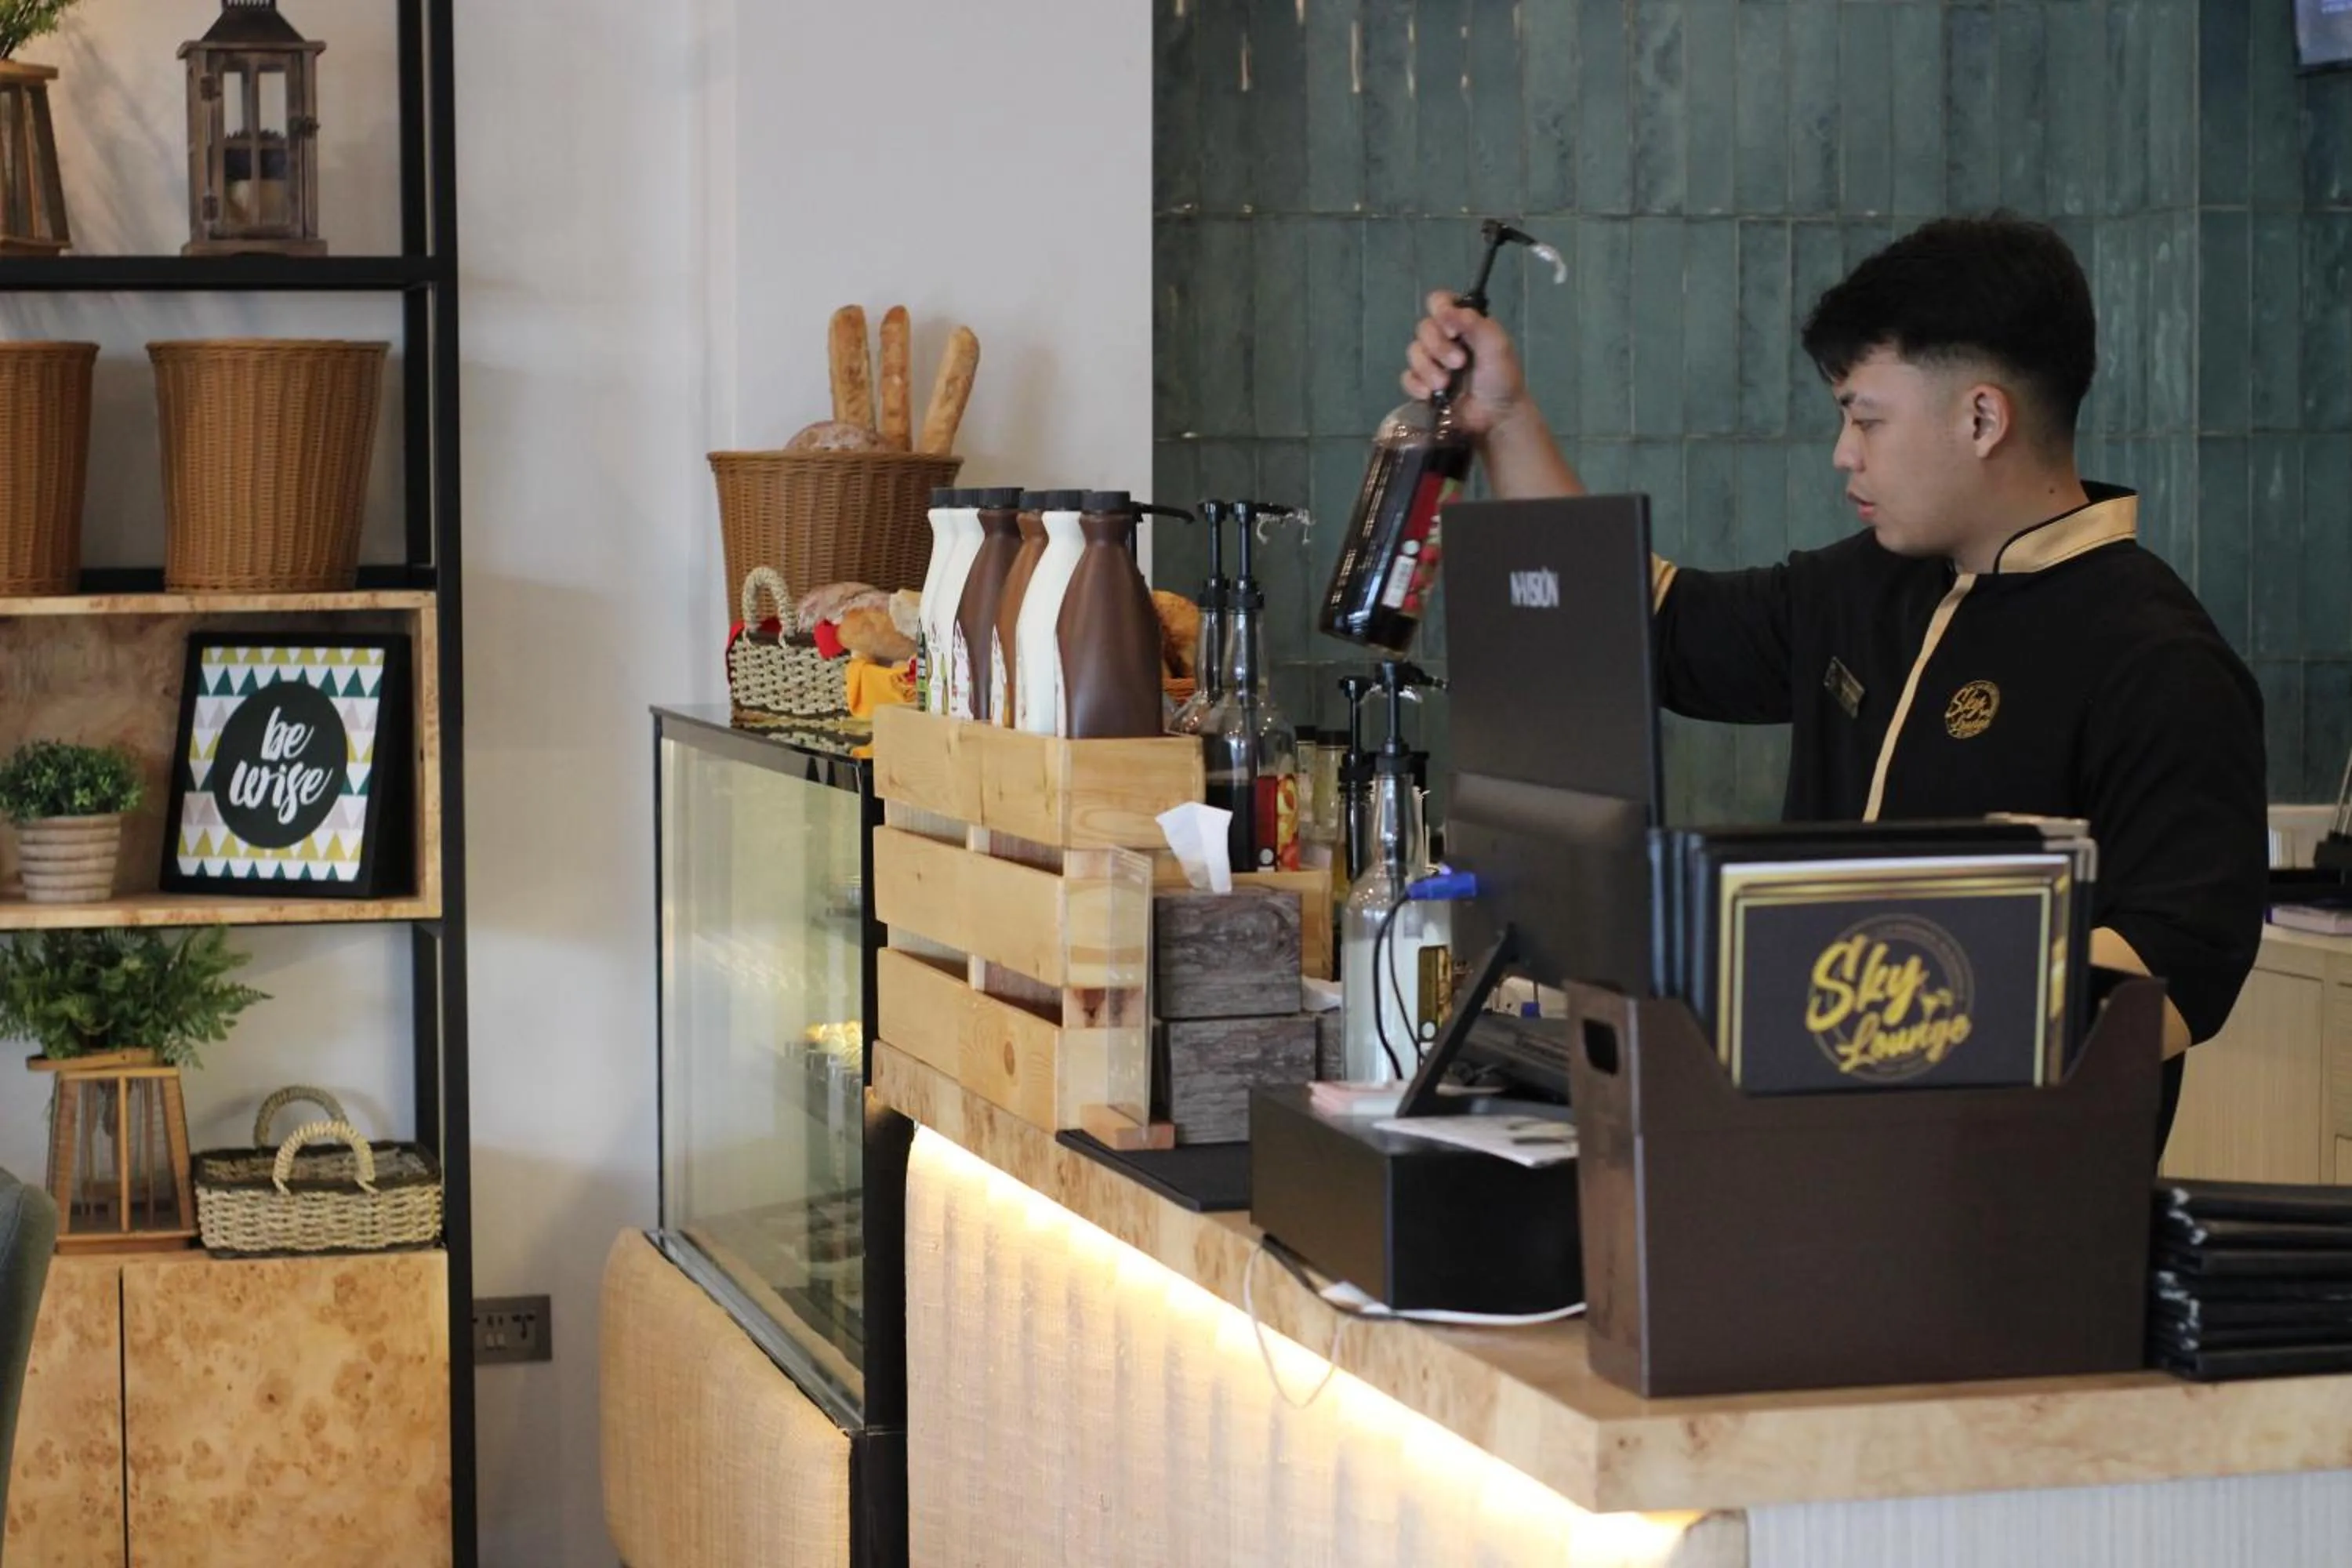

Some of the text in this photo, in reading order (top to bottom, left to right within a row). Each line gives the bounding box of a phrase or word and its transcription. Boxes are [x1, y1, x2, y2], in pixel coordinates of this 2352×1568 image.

[260, 706, 314, 761] be
[228, 760, 333, 825] wise
[1806, 934, 1929, 1033] Sky
[1835, 1012, 1972, 1073] Lounge
